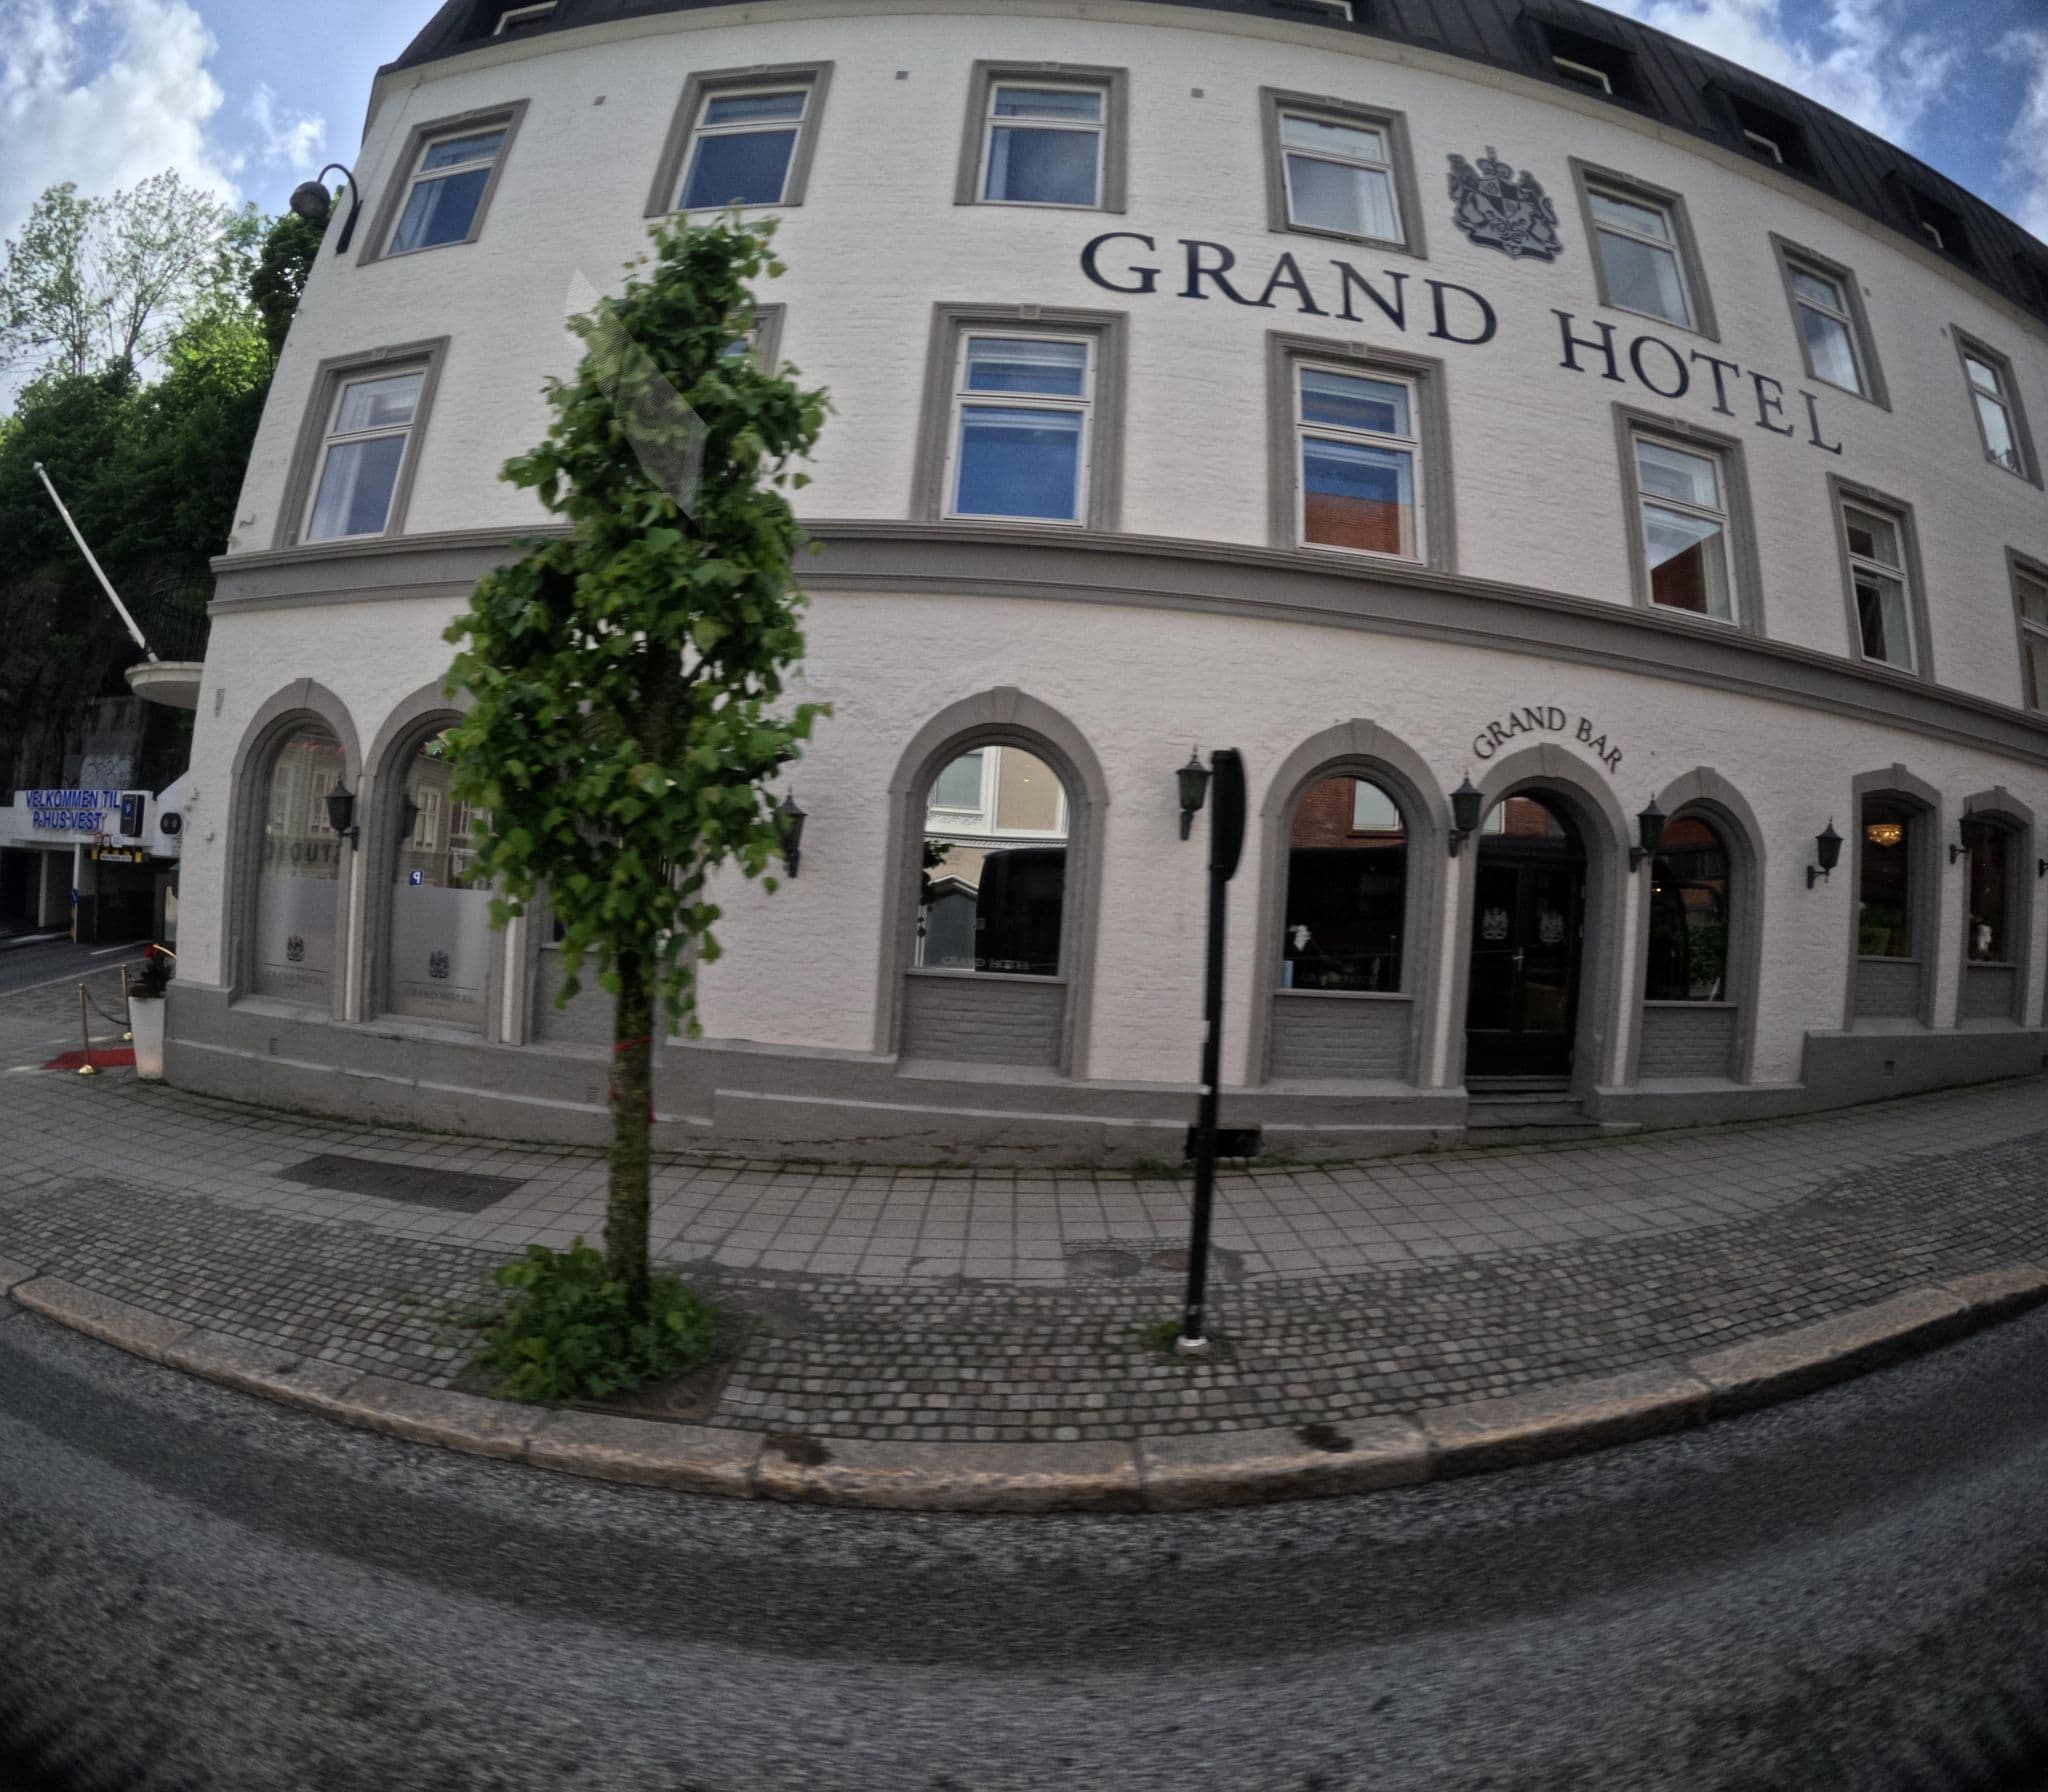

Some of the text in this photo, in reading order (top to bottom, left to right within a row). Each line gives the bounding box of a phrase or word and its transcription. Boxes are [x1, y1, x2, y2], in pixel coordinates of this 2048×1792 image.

[1080, 232, 1844, 455] GRAND HOTEL
[1472, 706, 1623, 775] GRAND BAR
[26, 790, 120, 808] VELKOMMEN TIL
[71, 811, 102, 830] VEST
